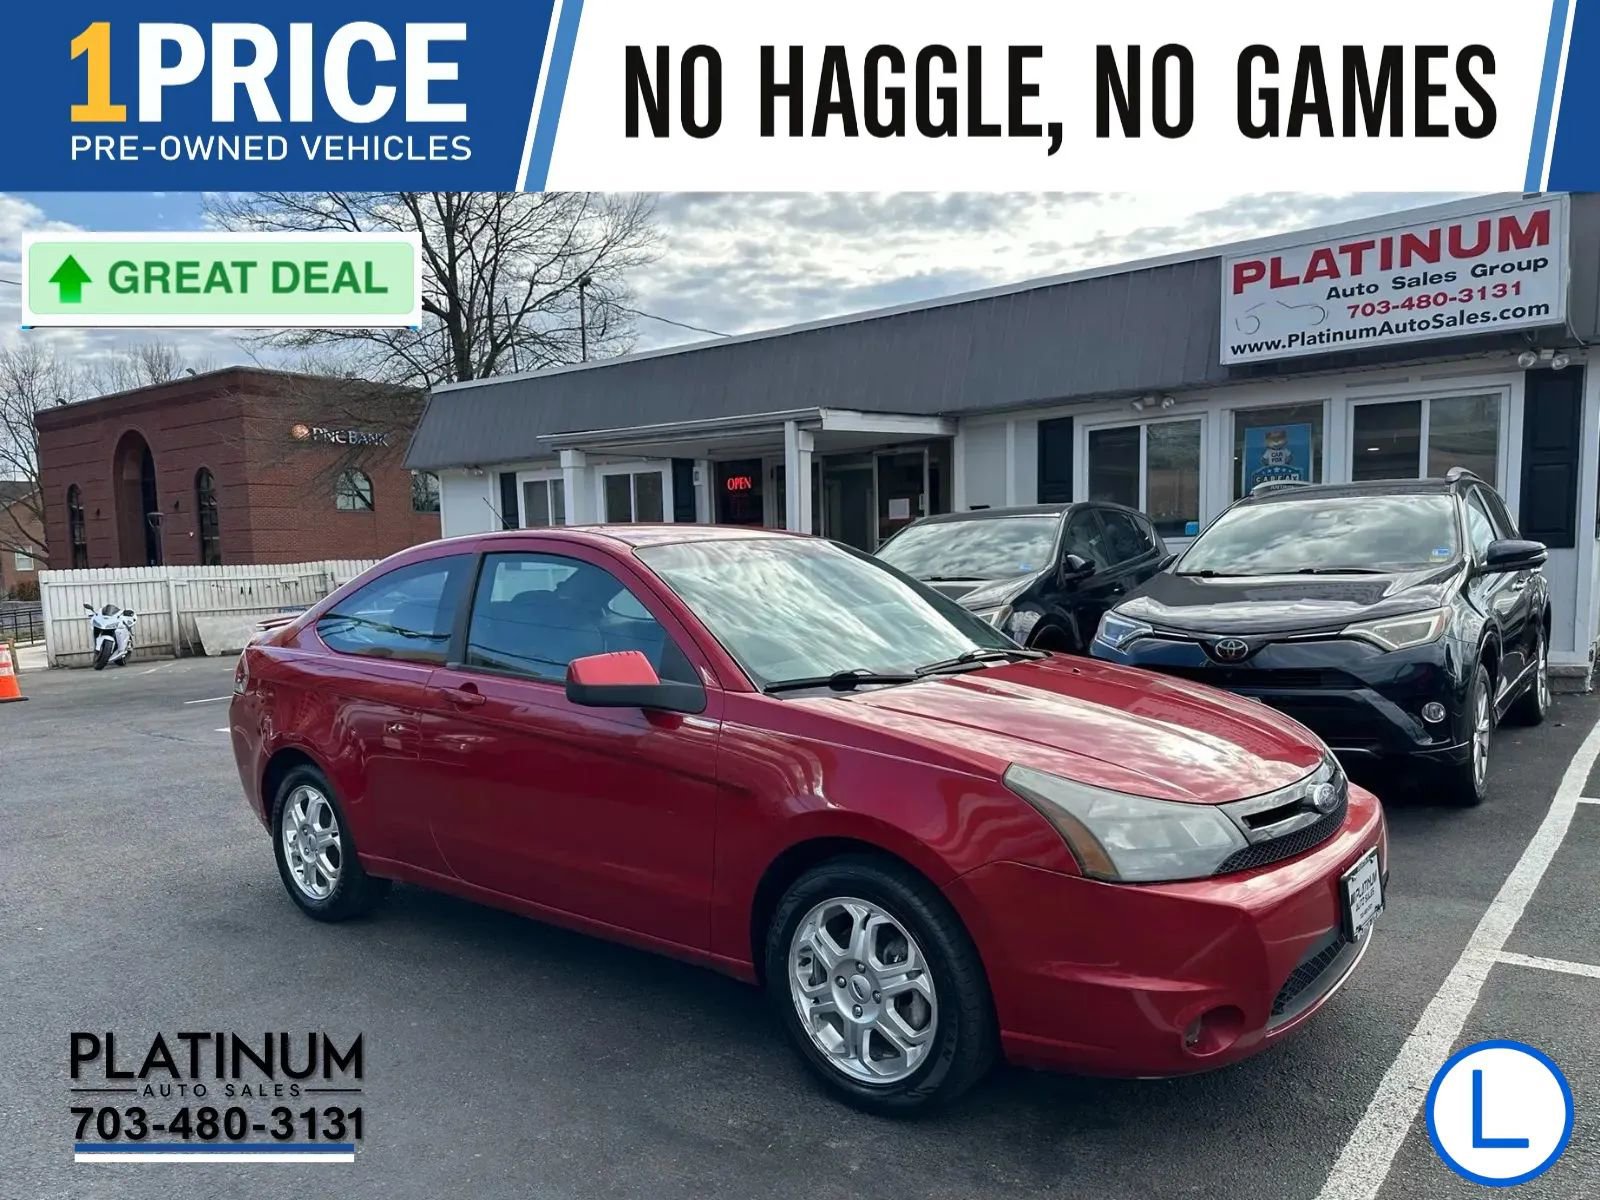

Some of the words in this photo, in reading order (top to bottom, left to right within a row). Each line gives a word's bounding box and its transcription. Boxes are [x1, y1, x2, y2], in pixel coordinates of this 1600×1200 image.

[1233, 209, 1551, 295] PLATINUM
[1326, 283, 1379, 300] Auto
[1391, 270, 1457, 291] Sales
[1470, 256, 1549, 279] Group
[1346, 281, 1522, 319] 703-480-3131
[1230, 303, 1550, 356] www.PlatinumAutoSales.com
[727, 476, 752, 490] OPEN
